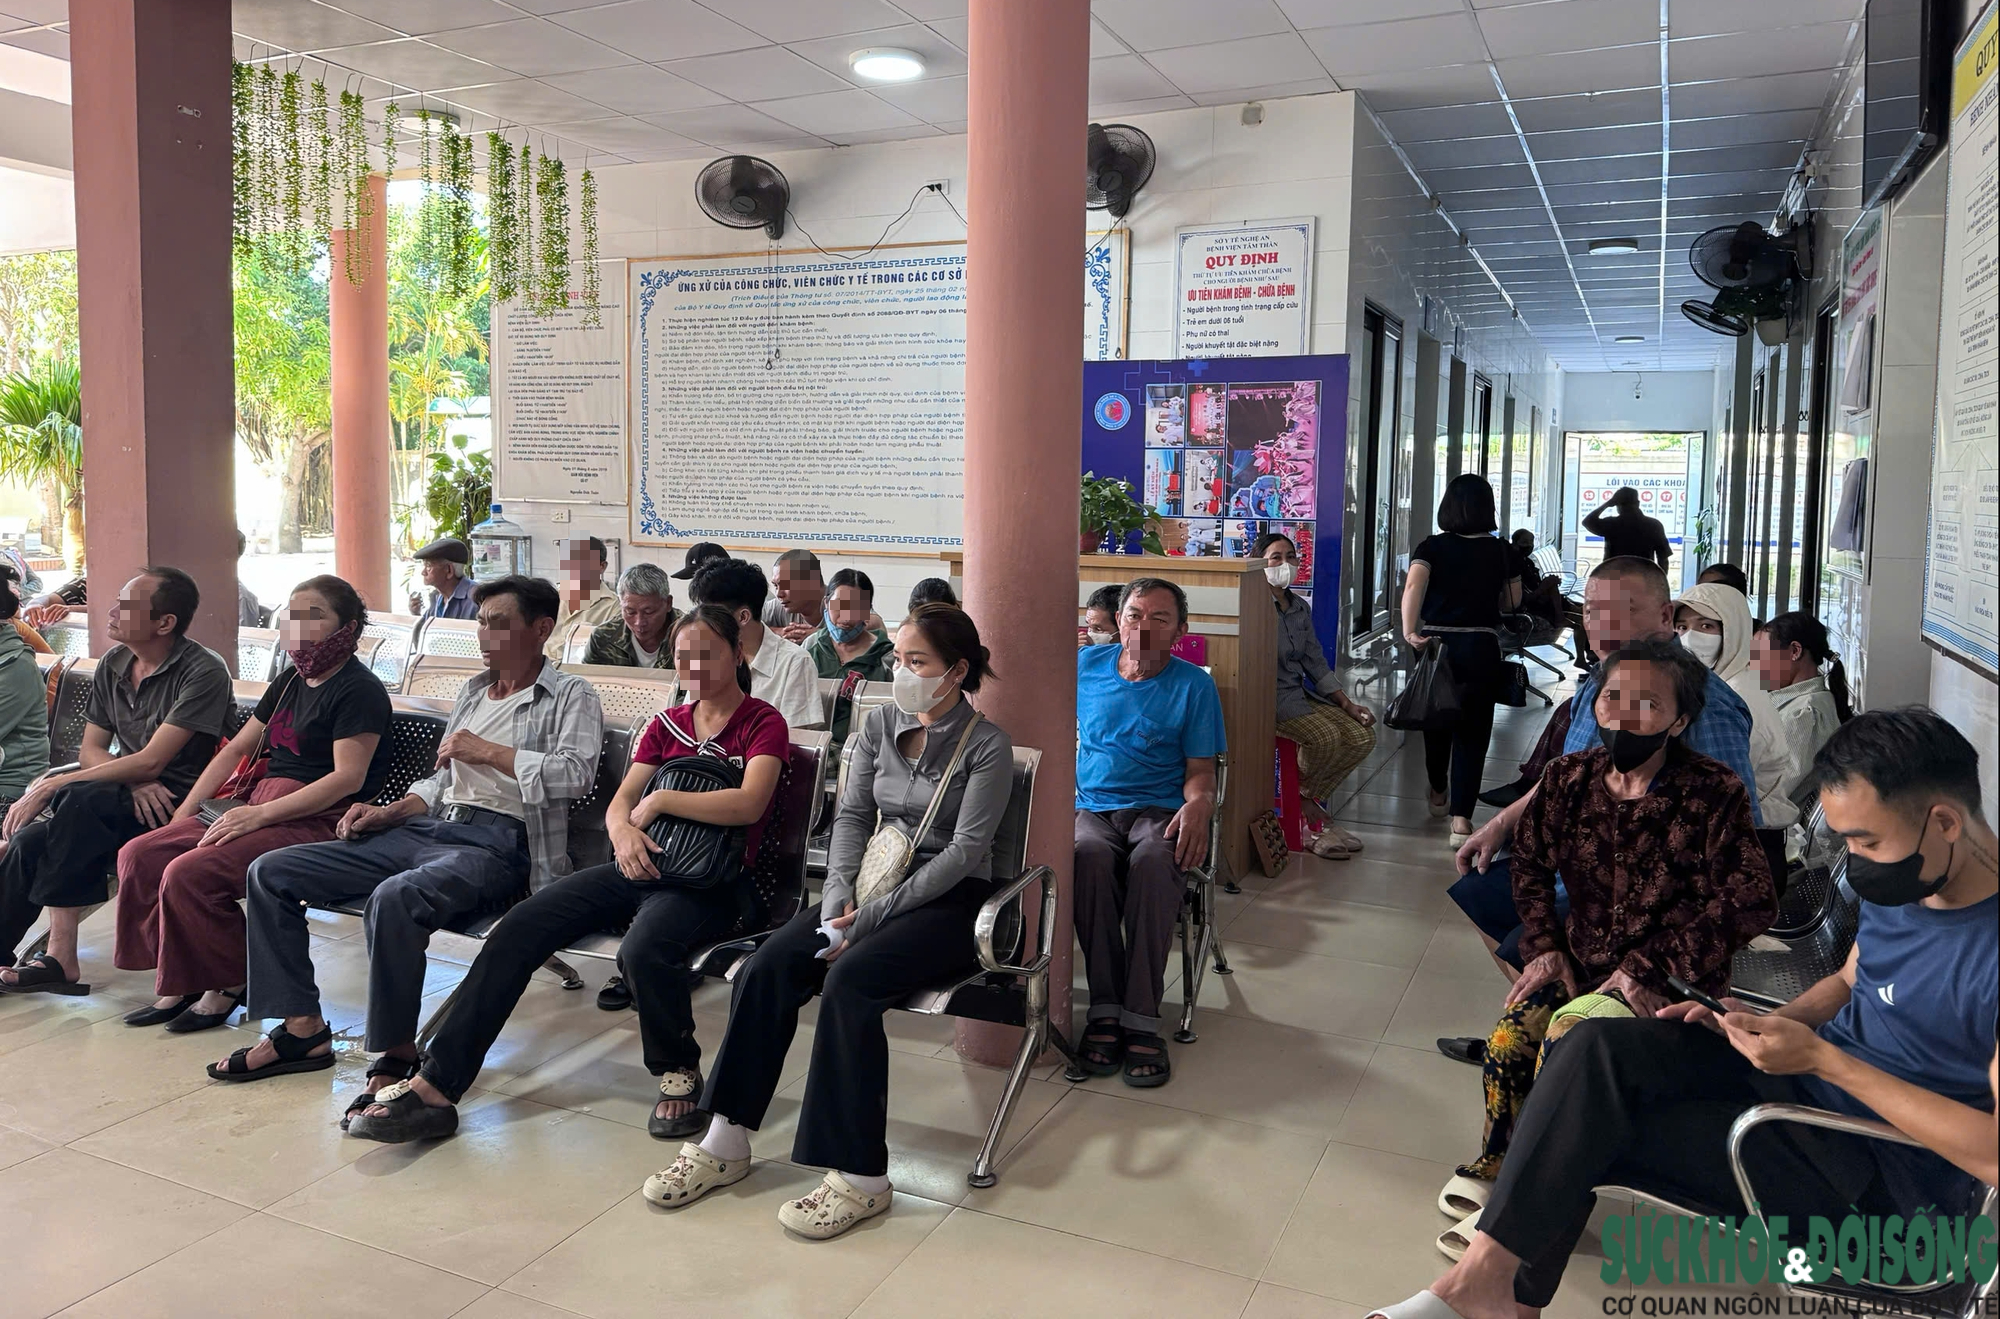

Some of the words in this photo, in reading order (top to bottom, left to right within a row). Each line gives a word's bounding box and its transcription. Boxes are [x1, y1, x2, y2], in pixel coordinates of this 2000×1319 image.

[1976, 29, 1998, 77] QUY
[1240, 235, 1259, 244] NGHỆ
[1206, 244, 1224, 253] BỆNH
[1226, 243, 1241, 252] VIỆN
[1260, 240, 1278, 248] THẦN
[1206, 254, 1237, 270] QUY
[1240, 252, 1279, 268] ĐỊNH
[678, 281, 696, 293] ỨNG
[700, 280, 710, 292] XỬ
[714, 279, 732, 291] CỦA
[735, 278, 759, 290] CÔNG
[762, 276, 791, 290] CHỨC,
[794, 275, 816, 288] VIÊN
[820, 274, 845, 286] CHỨC
[848, 275, 854, 285] Y
[857, 271, 869, 285] TẾ
[871, 273, 904, 284] TRONG
[908, 270, 928, 282] CÁC
[931, 271, 945, 281] CƠ
[948, 267, 962, 280] SỞ
[791, 292, 813, 300] Thông
[1187, 289, 1197, 301] ƯU
[1198, 286, 1212, 301] TIÊN
[1214, 285, 1232, 300] KHÁM
[1234, 284, 1251, 301] BỆNH
[1258, 283, 1275, 298] CHỮA
[1277, 282, 1295, 299] BỆNH
[1187, 306, 1204, 315] Người
[1223, 305, 1240, 313] trong
[1273, 301, 1285, 311] cấp
[1232, 314, 1244, 324] tuổi
[1186, 343, 1203, 351] Người
[1204, 341, 1225, 350] khuyết
[1262, 340, 1279, 349] nặng
[1623, 478, 1640, 486] VÀO
[1643, 478, 1661, 486] CÁC
